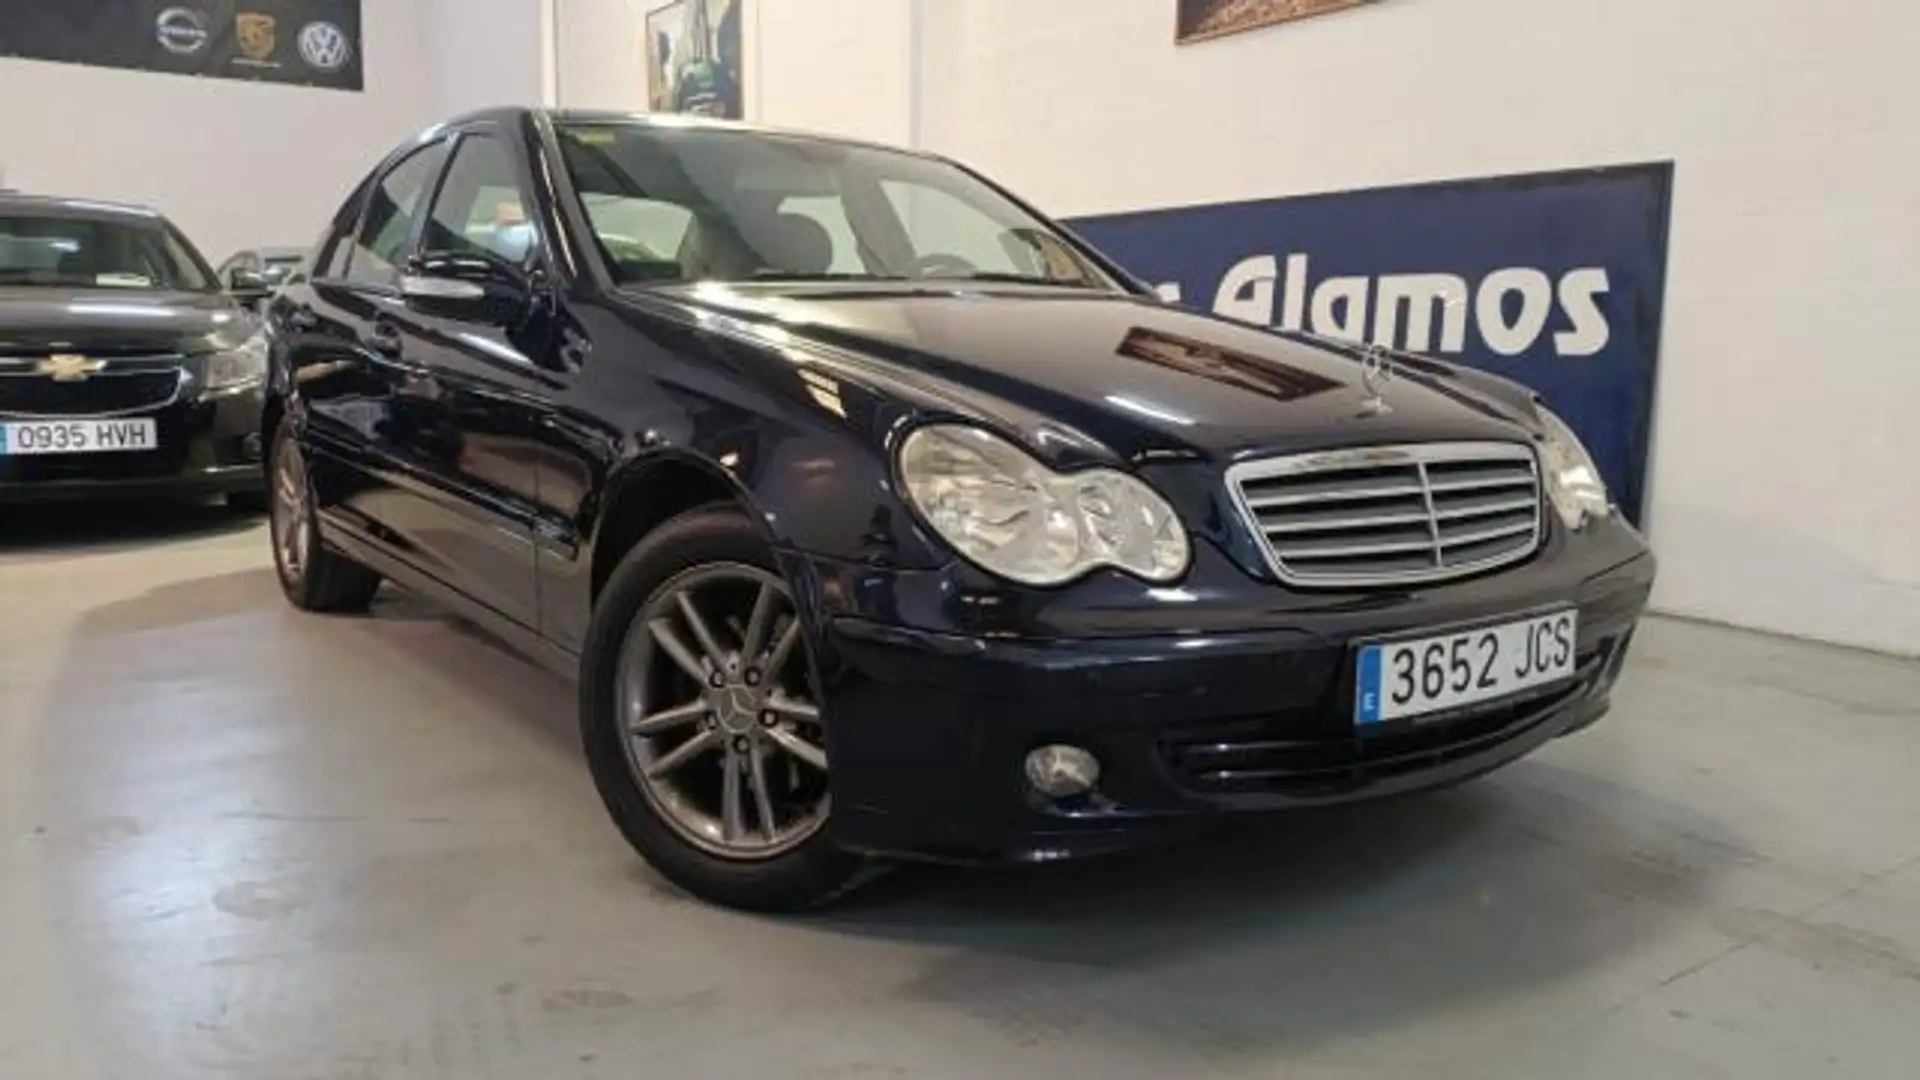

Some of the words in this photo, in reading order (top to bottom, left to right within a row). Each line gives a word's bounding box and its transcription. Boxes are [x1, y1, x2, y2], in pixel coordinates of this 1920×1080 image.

[1212, 253, 1610, 356] Alamos
[18, 425, 86, 449] 0935
[96, 423, 146, 446] HVH
[1391, 632, 1500, 705] 3652
[1514, 616, 1571, 679] JCS
